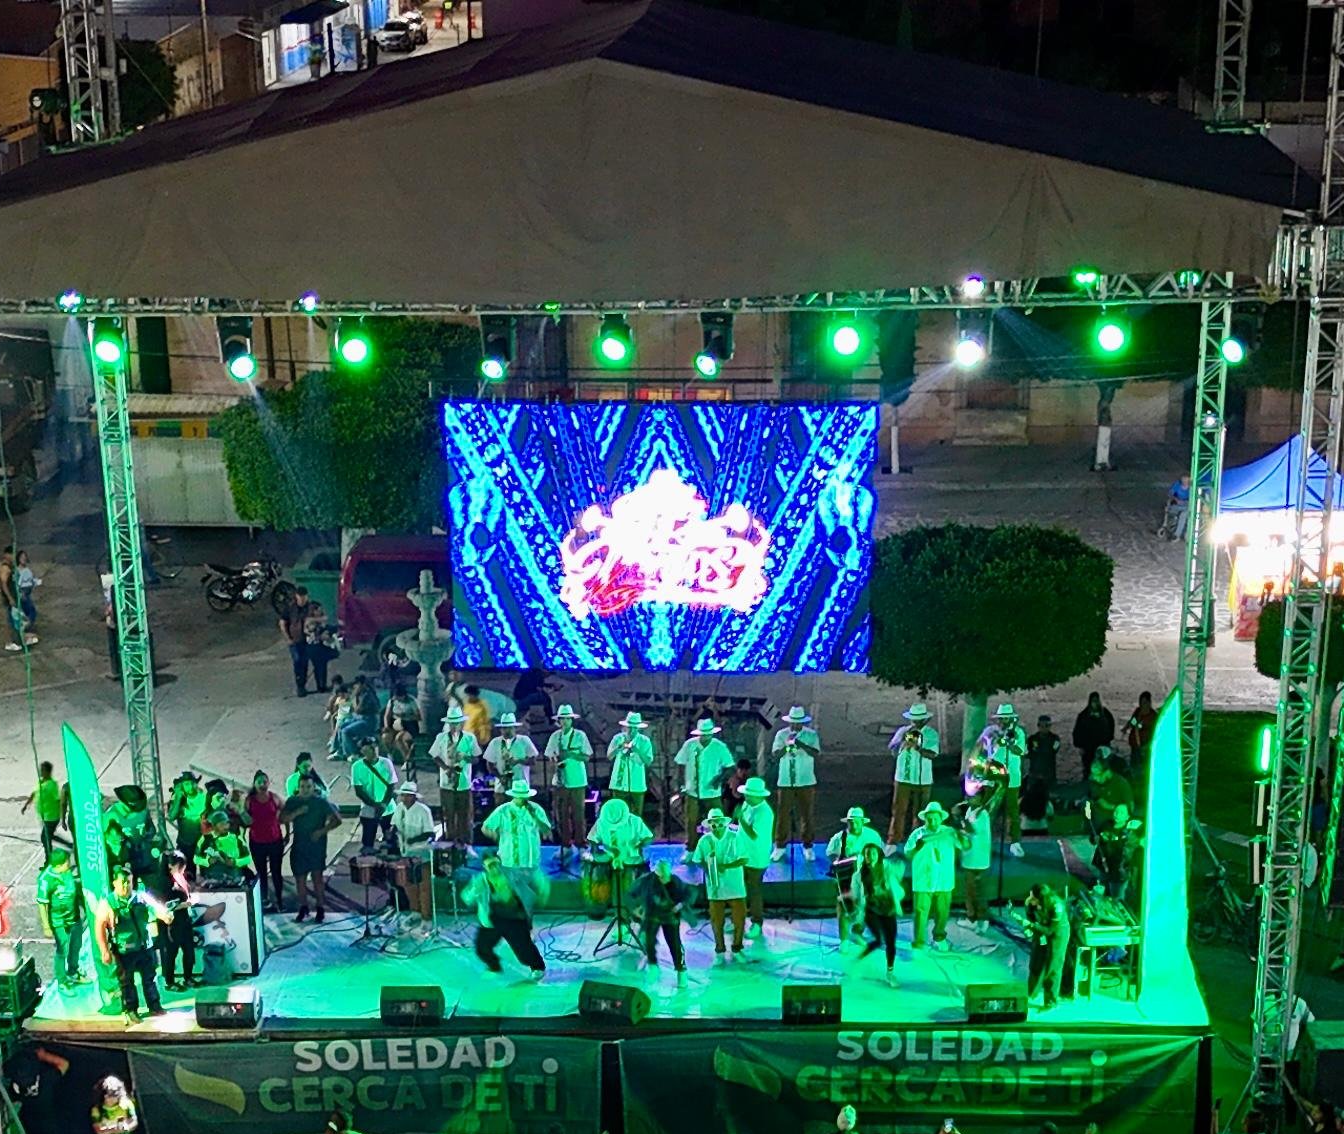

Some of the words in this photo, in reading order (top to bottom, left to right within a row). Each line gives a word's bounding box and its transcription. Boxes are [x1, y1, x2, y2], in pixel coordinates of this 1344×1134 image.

[293, 1035, 516, 1073] SOLEDAD
[836, 1030, 1064, 1062] SOLEDAD
[258, 1073, 426, 1113] CERCA
[441, 1071, 504, 1112] DE
[794, 1064, 965, 1104] CERCA
[977, 1066, 1045, 1103] DE
